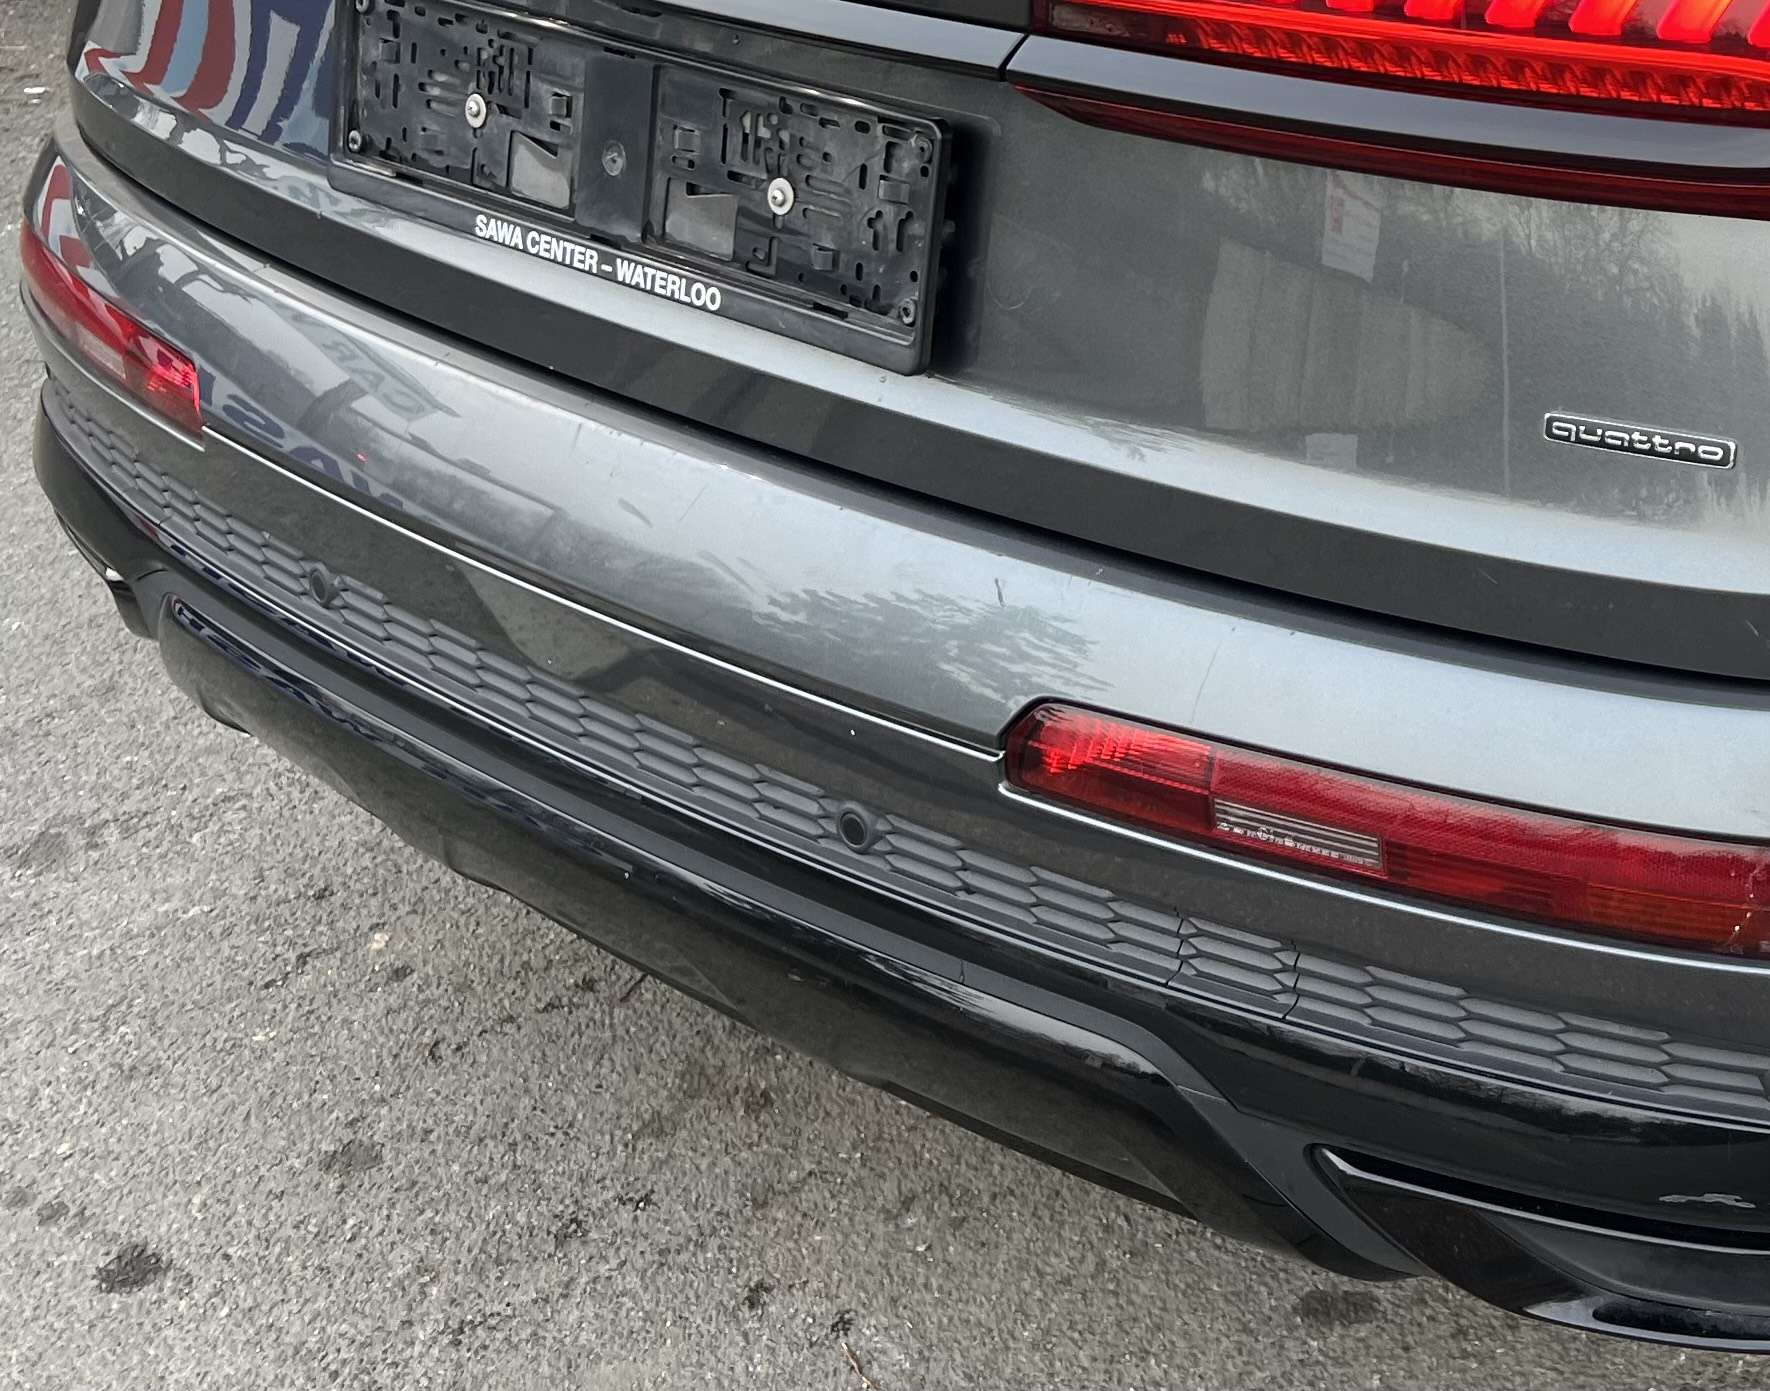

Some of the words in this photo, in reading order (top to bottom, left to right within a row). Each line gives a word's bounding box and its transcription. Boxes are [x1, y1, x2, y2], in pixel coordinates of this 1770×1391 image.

[474, 214, 524, 251] SAWA
[526, 229, 599, 275] CENTER
[615, 258, 722, 312] WATERLOO
[1551, 420, 1725, 462] quattro
